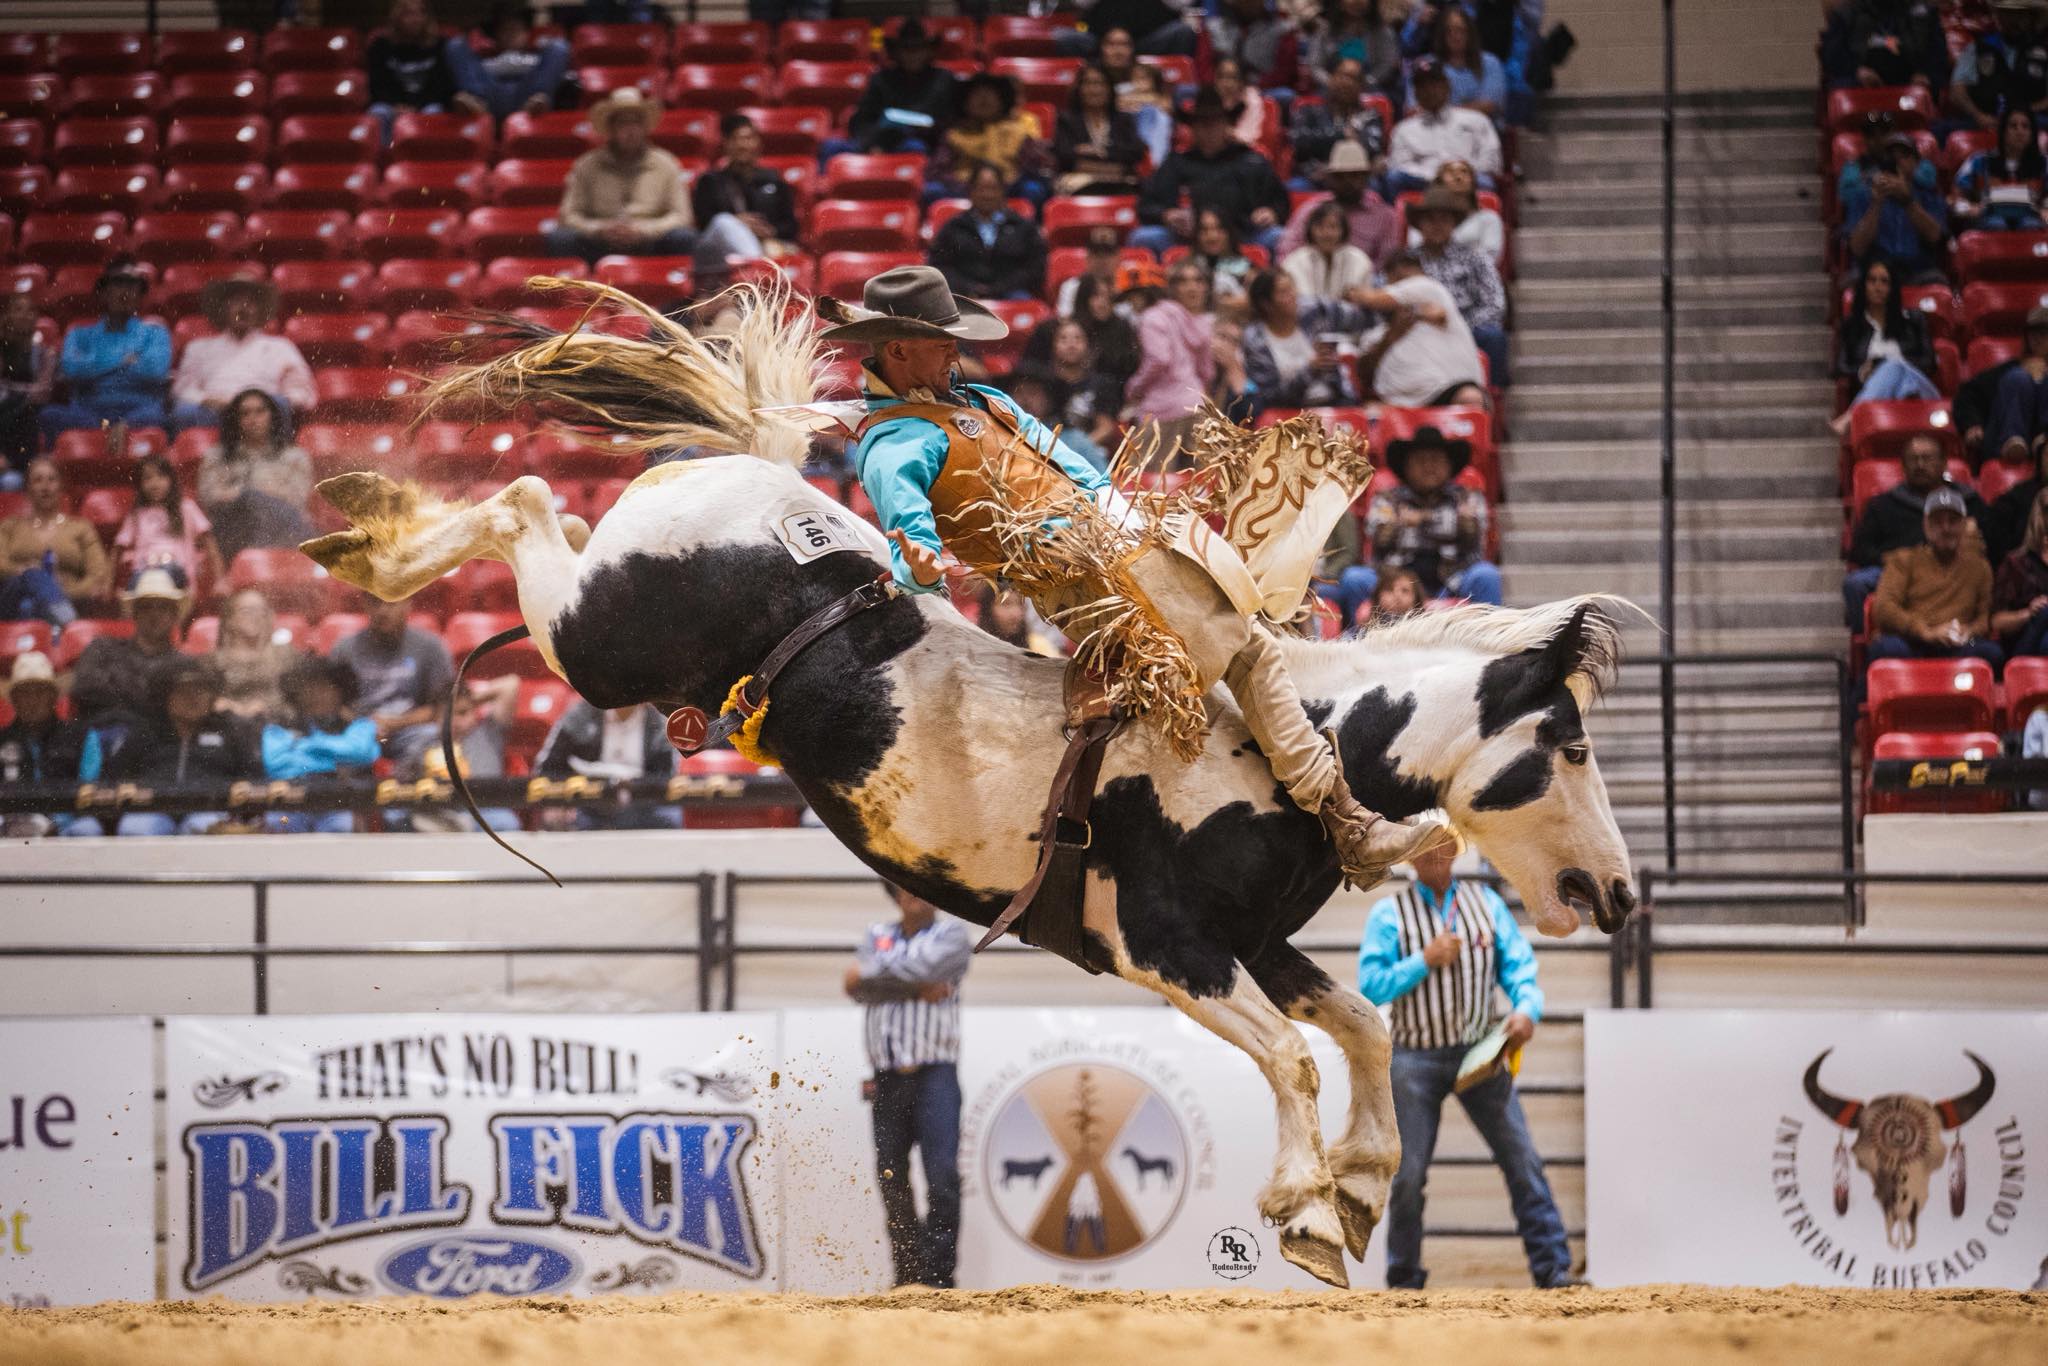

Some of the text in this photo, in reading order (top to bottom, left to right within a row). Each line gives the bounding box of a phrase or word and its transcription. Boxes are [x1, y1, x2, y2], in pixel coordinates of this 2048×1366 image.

[797, 516, 831, 547] 146
[316, 1033, 638, 1098] THAT'S NO BULL!
[188, 1118, 758, 1284] BILL FICK
[1772, 1115, 2025, 1289] INTERTRIBAL BUFFALO COUNCIL
[416, 1239, 542, 1293] Ford
